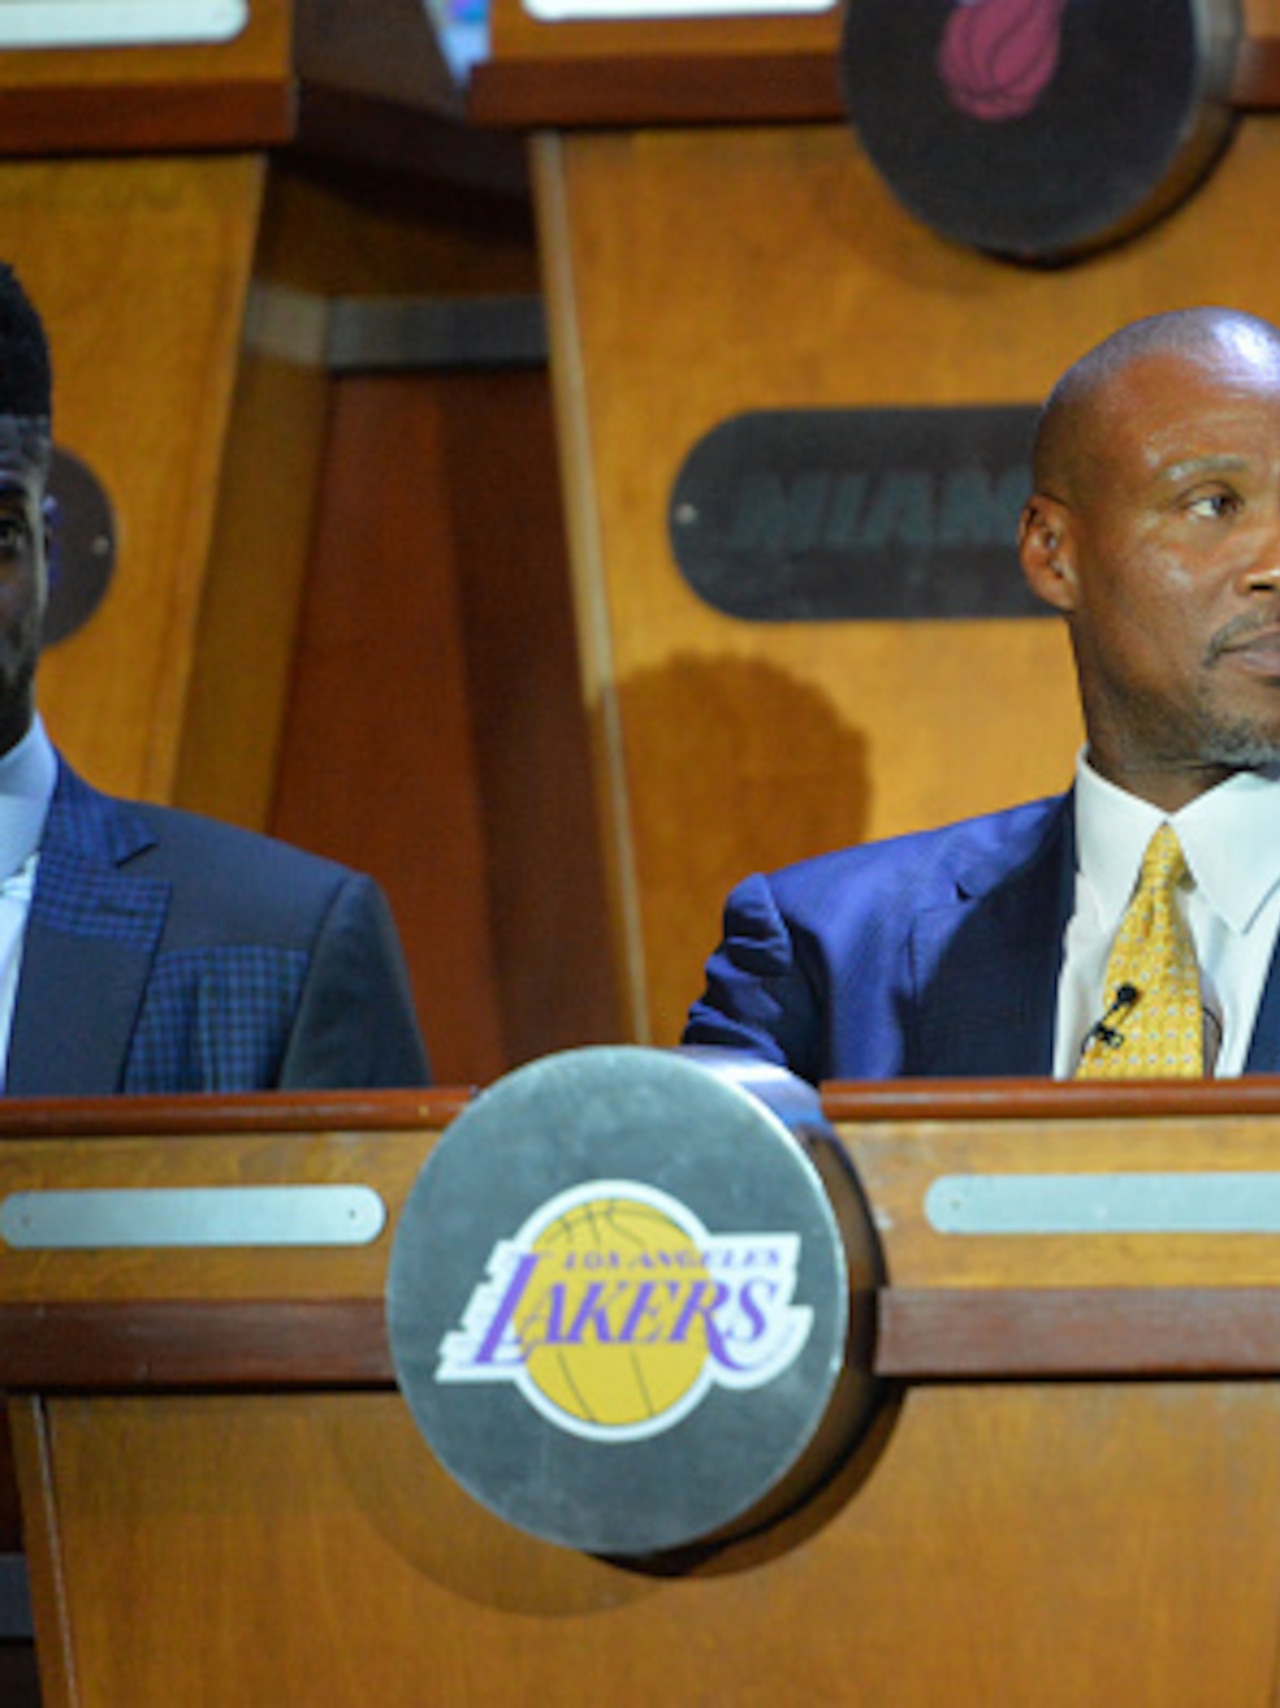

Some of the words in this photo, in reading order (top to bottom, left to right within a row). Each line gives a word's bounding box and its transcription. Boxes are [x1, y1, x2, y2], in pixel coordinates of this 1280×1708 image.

[727, 469, 1034, 548] MIAM
[562, 1250, 624, 1269] LOS
[629, 1249, 780, 1268] ANGELES
[471, 1252, 783, 1371] LAKERS
